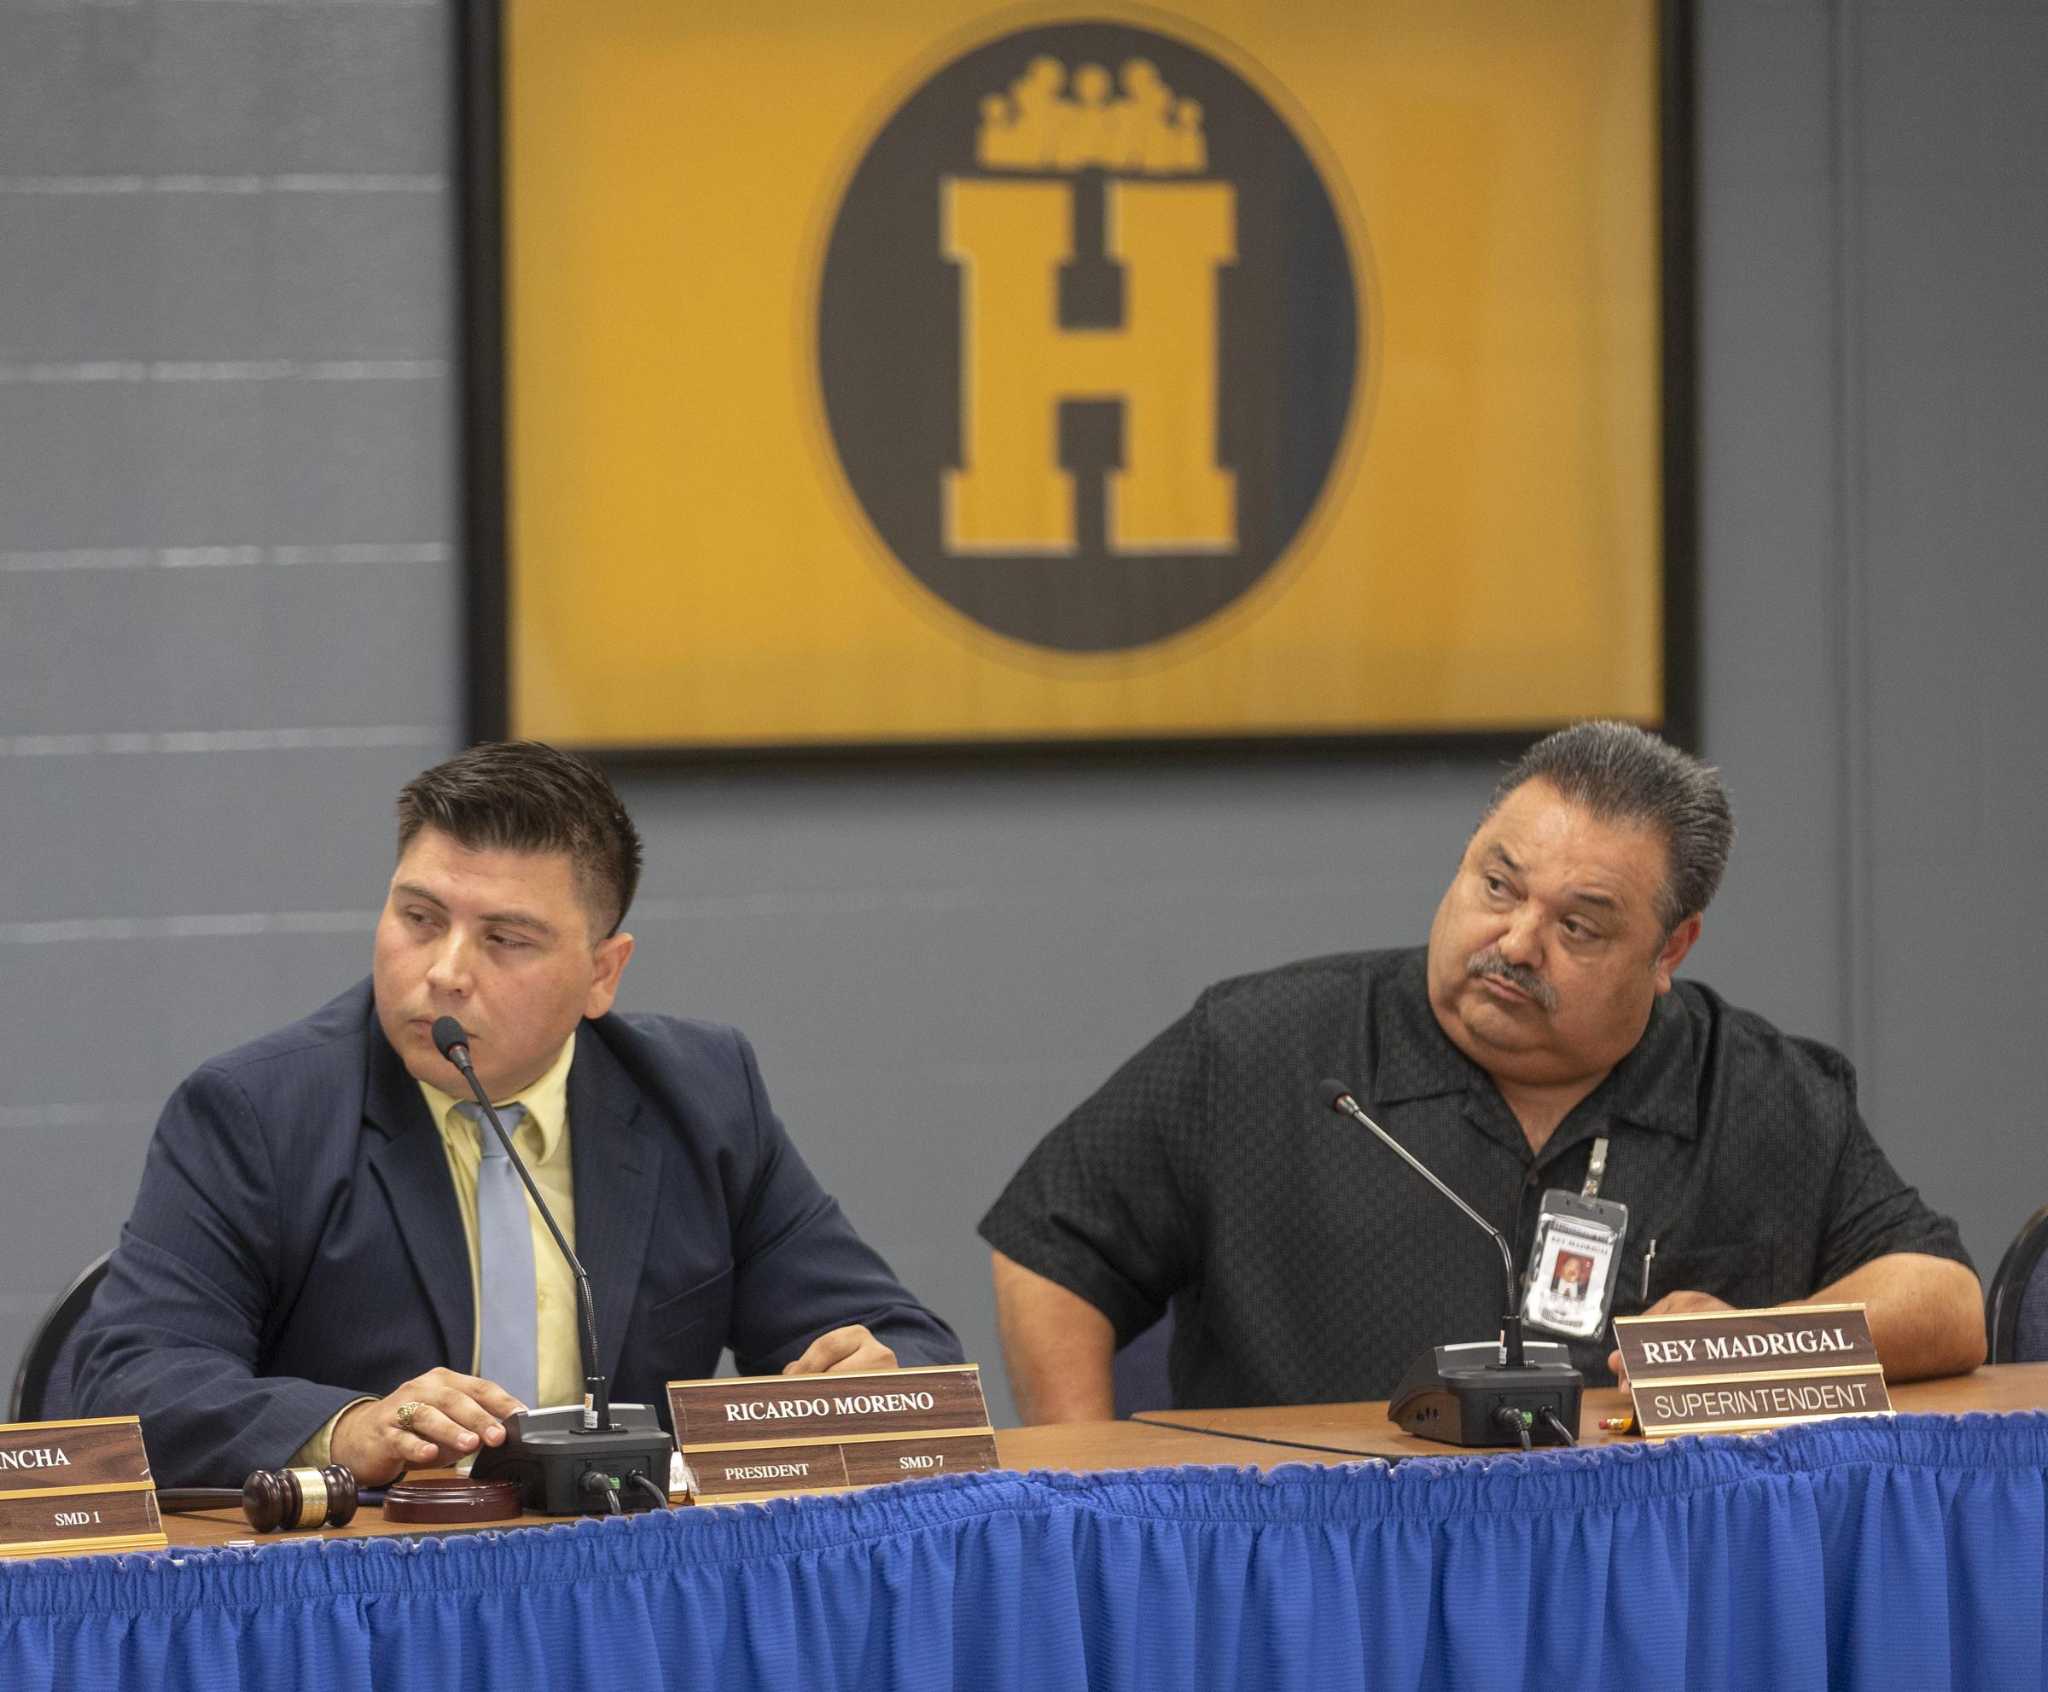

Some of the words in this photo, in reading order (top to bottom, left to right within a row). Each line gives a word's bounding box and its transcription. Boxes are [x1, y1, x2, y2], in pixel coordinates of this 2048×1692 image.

[940, 176, 1237, 555] H
[1641, 1338, 1697, 1365] REY
[1703, 1327, 1854, 1360] MADRIGAL
[724, 1397, 830, 1422] RICARDO
[835, 1391, 934, 1415] MORENO
[1654, 1383, 1868, 1419] SUPERINTENDENT
[0, 1447, 72, 1470] NCHA
[724, 1463, 810, 1481] PRESIDENT
[899, 1456, 934, 1470] SMD
[937, 1455, 944, 1467] 7
[54, 1512, 91, 1527] SMD
[94, 1511, 101, 1524] 1
